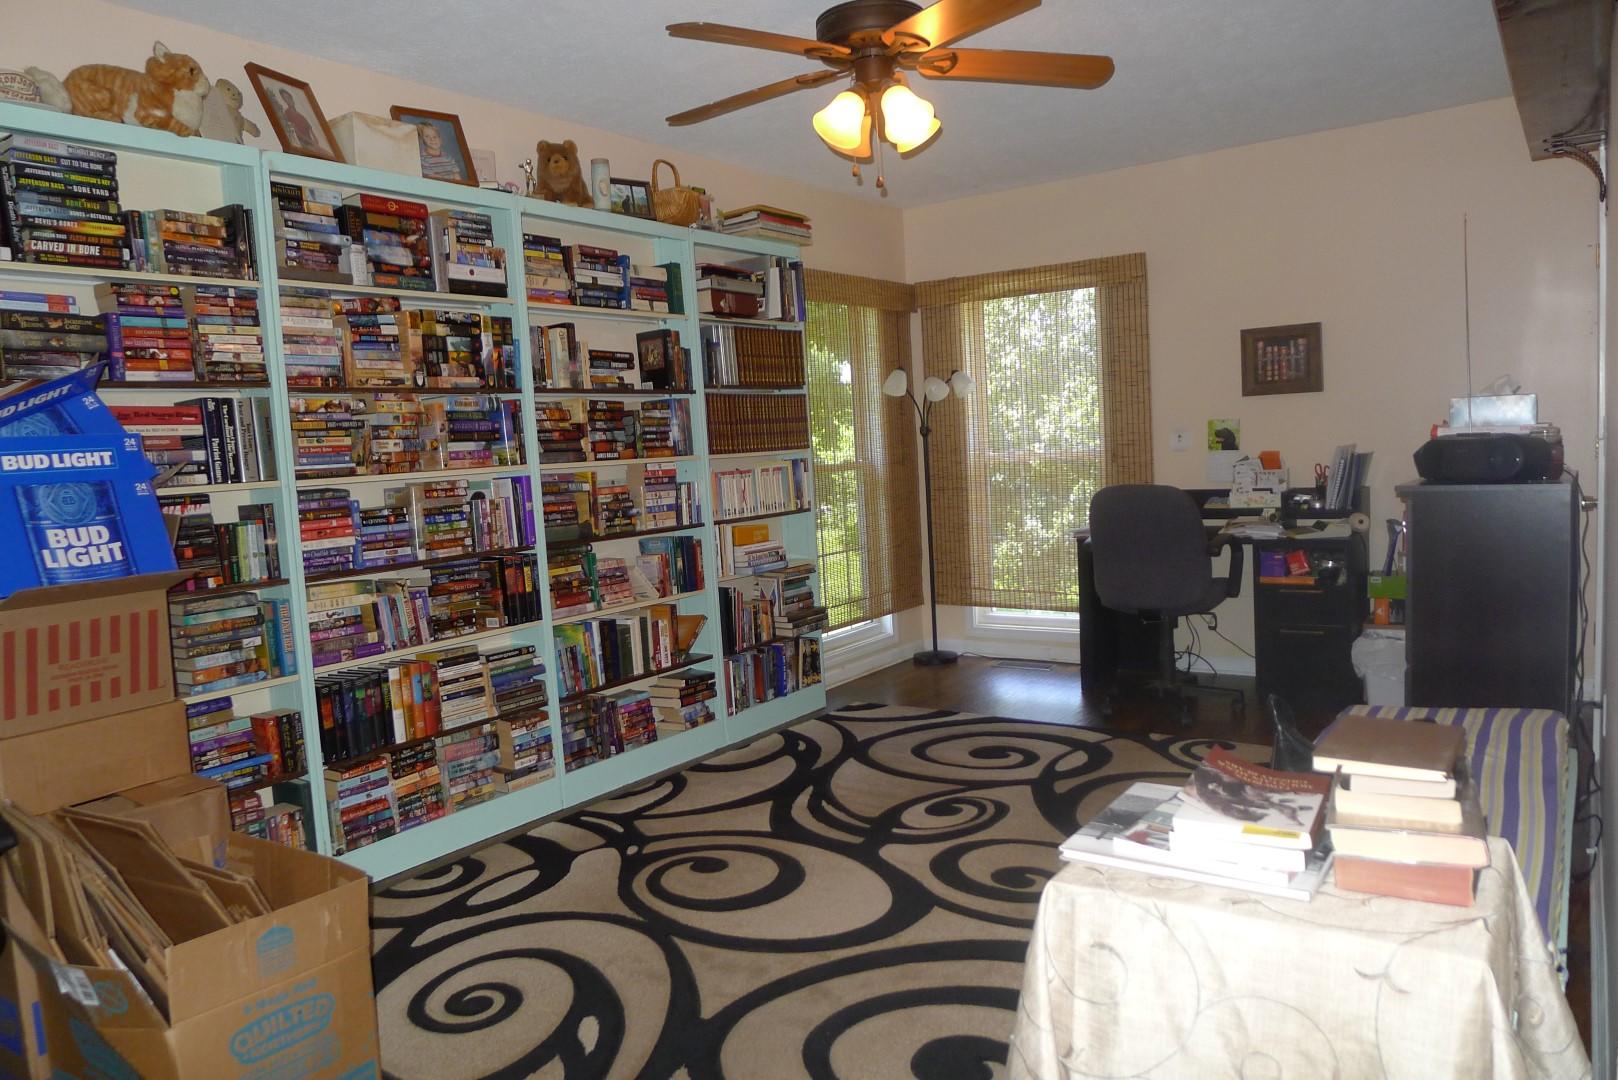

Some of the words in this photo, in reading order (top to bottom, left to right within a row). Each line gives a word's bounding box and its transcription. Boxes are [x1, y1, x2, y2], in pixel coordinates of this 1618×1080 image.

[16, 152, 42, 161] JEFFERSON
[43, 156, 58, 164] BASS
[24, 168, 51, 176] JEFFERSON
[90, 163, 103, 171] BONE
[18, 178, 49, 187] JEFFERSON
[73, 186, 91, 194] BONE
[92, 188, 110, 196] YARD
[34, 218, 57, 226] DEVIL'S
[58, 220, 78, 228] BONES
[31, 240, 65, 252] CARVED
[67, 243, 76, 253] IN
[79, 244, 100, 256] BONE
[18, 384, 72, 410] LIGHT
[82, 396, 95, 406] 24
[124, 438, 136, 446] 24
[212, 438, 221, 460] Patriot
[2, 452, 50, 470] BUD
[53, 451, 113, 468] LIGHT
[214, 460, 222, 482] Games
[45, 526, 110, 548] BUD
[42, 542, 122, 568] LIGHT
[234, 1000, 328, 1048] QUILTED
